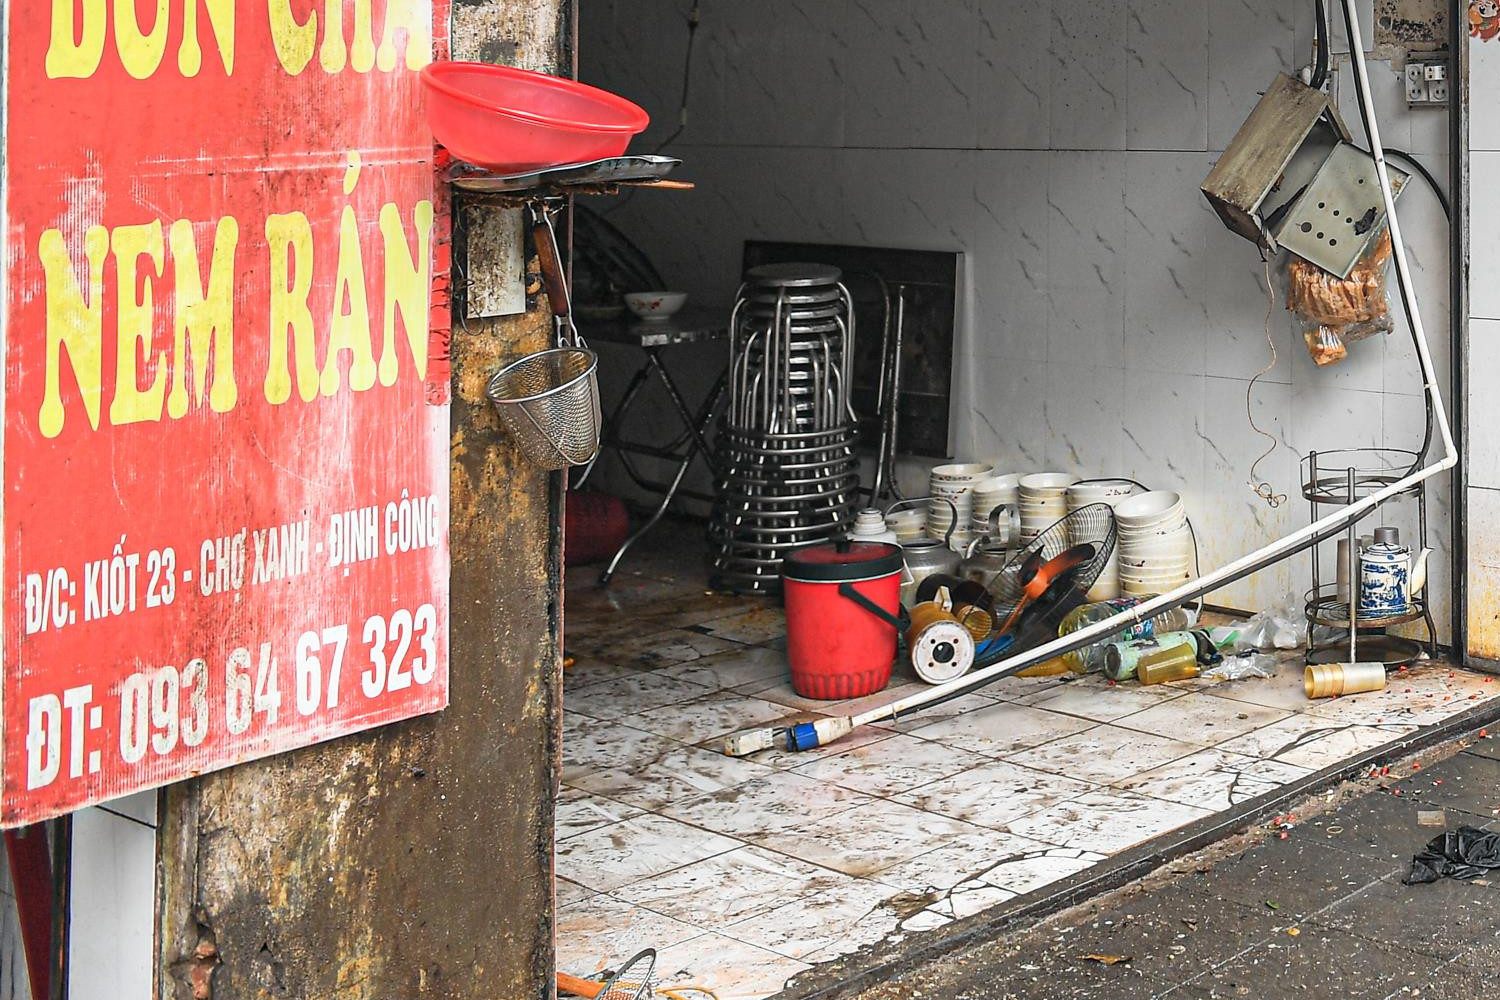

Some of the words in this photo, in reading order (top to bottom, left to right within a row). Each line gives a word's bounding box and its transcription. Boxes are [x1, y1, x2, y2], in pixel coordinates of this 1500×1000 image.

[37, 214, 240, 438] NEM
[263, 149, 435, 405] RÁN
[24, 566, 78, 635] Đ/C:
[84, 534, 140, 622] KIỐT
[145, 546, 176, 609] 23
[199, 527, 248, 603] CHỢ
[252, 519, 310, 586] XANH
[329, 504, 379, 577] ĐỊNH
[385, 488, 440, 554] CÔNG
[25, 684, 103, 791] ĐT:
[119, 657, 209, 765] 093
[225, 641, 281, 734] 64
[296, 623, 350, 716] 67
[361, 603, 438, 699] 323
